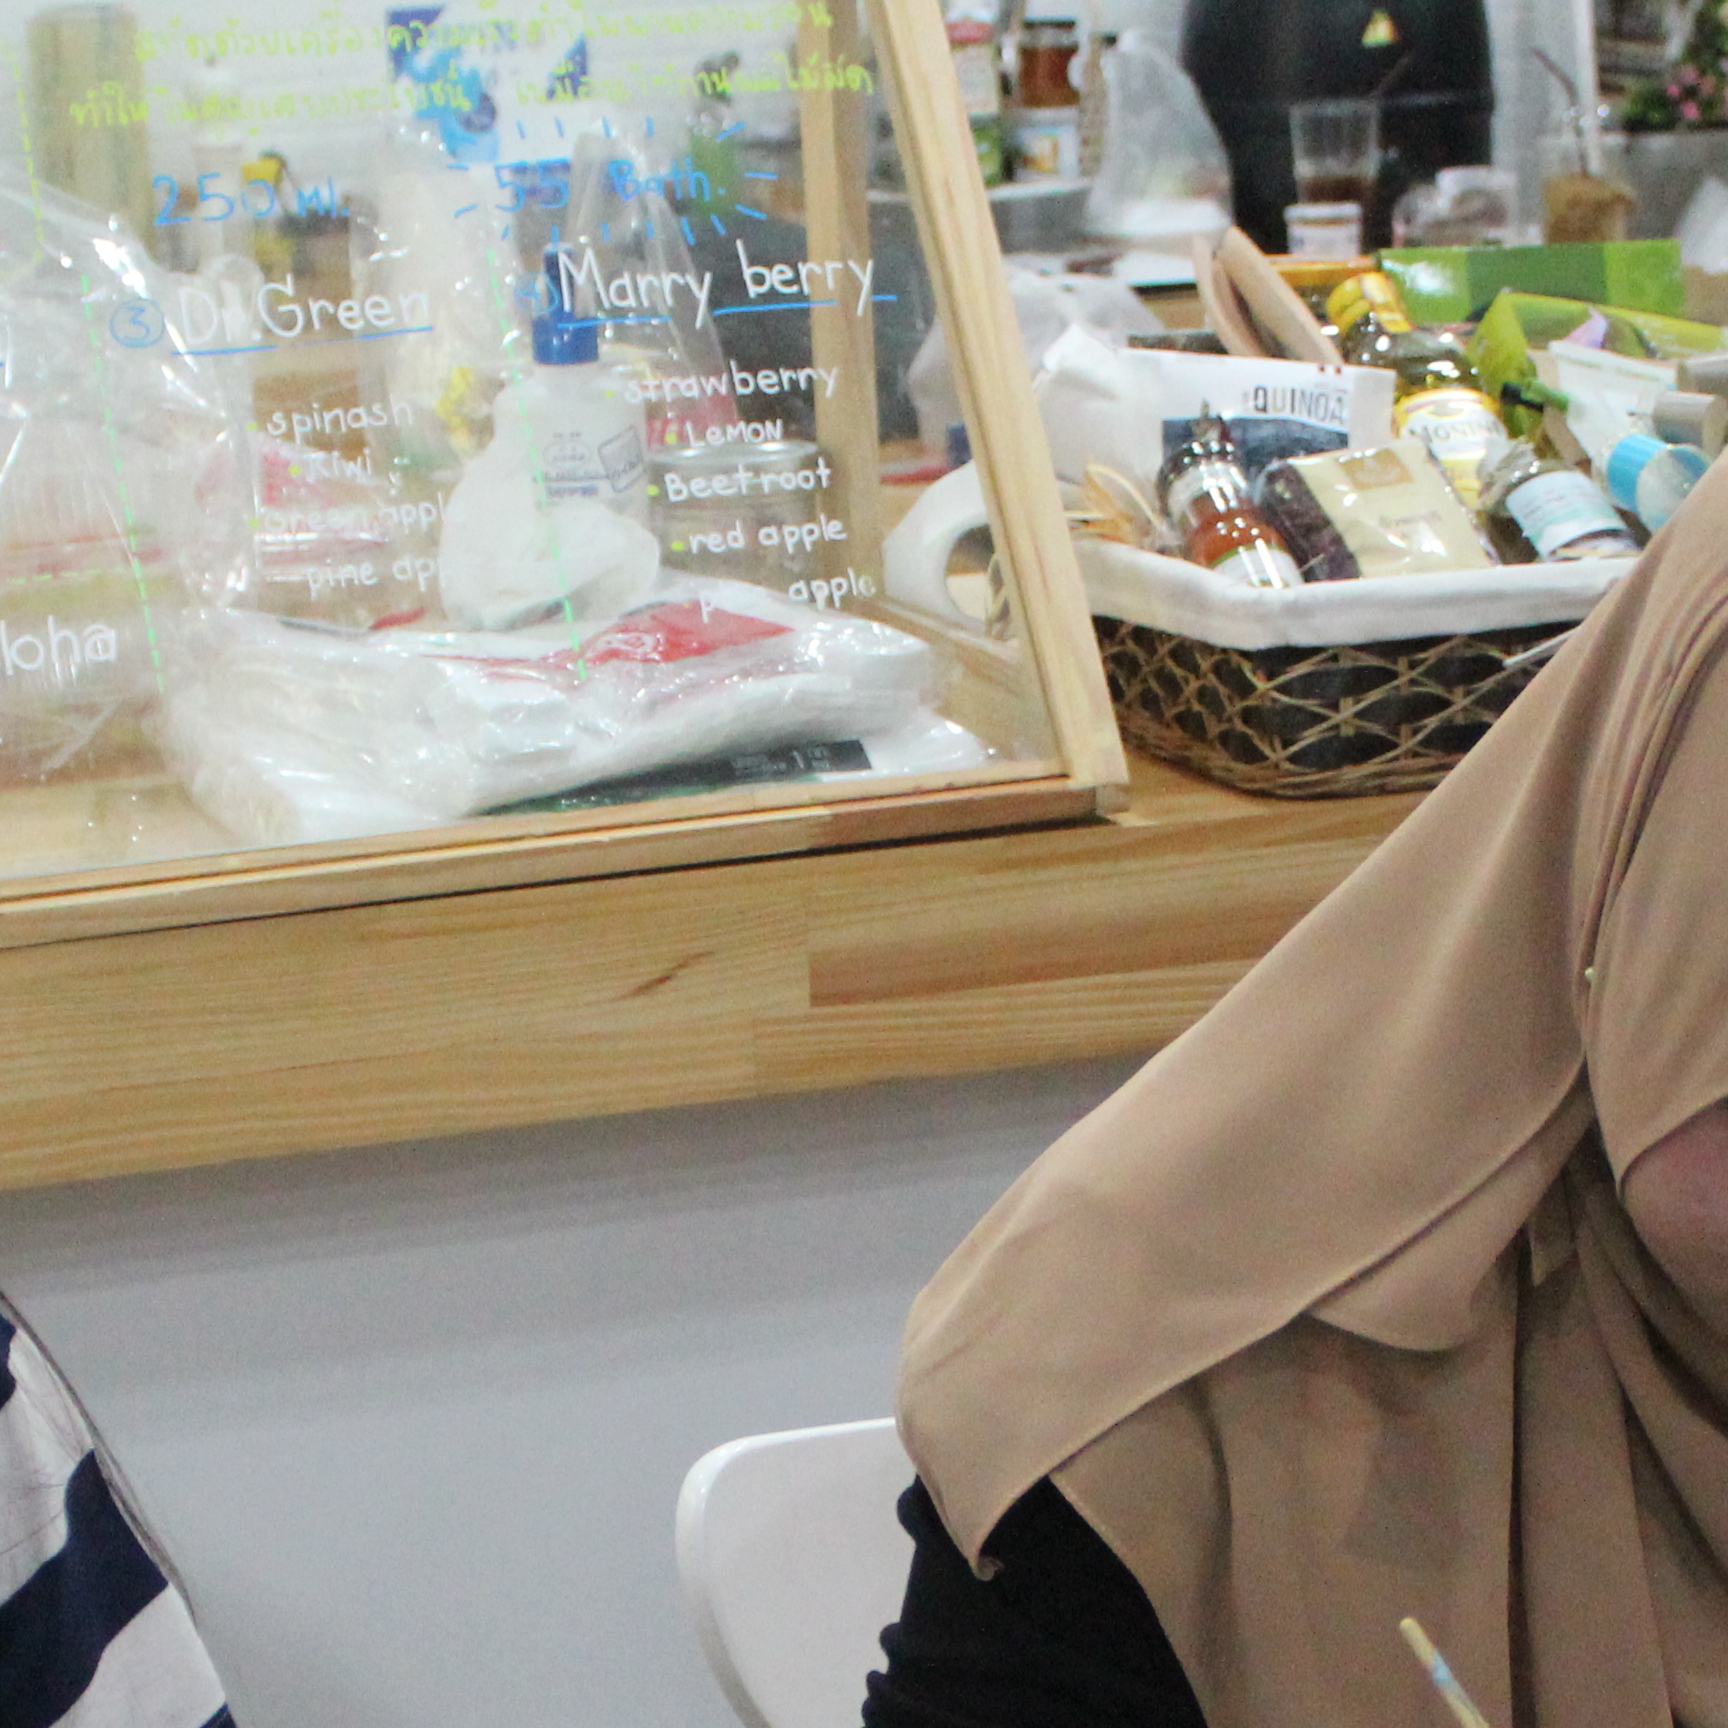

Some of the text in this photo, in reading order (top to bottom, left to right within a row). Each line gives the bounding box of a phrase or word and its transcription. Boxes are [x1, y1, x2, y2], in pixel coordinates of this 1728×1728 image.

[152, 173, 278, 228] 250
[494, 158, 571, 213] 55
[557, 247, 712, 329] Marry
[735, 238, 874, 316] berry
[624, 359, 839, 400] strawberry
[266, 401, 414, 446] spinash
[1252, 382, 1348, 427] QUINOA
[664, 456, 833, 502] Beetroot
[377, 491, 450, 534] appl
[689, 514, 848, 554] red apple
[788, 565, 877, 612] apple
